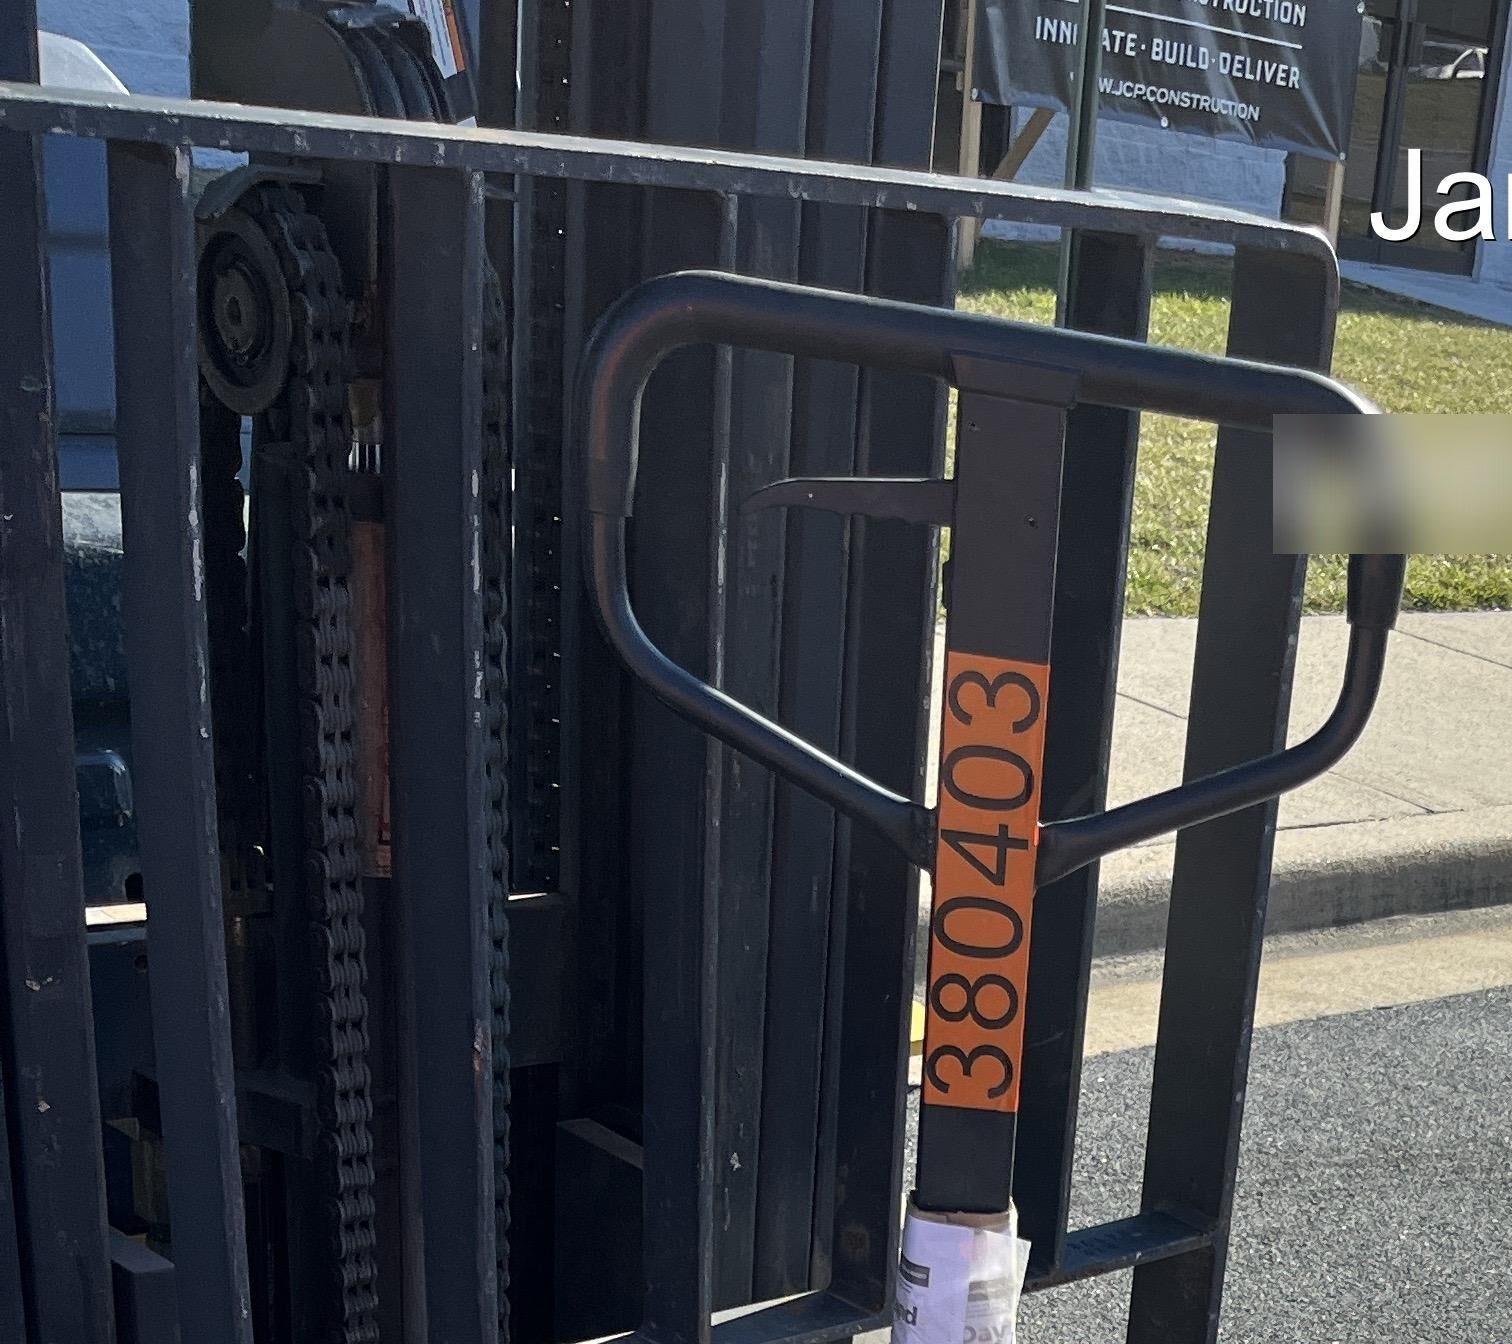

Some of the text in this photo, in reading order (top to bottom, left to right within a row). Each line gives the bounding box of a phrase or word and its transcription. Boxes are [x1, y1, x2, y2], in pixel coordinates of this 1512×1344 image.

[1151, 38, 1210, 71] BUILD
[1219, 52, 1301, 89] DELIVER
[925, 669, 1041, 1100] 380403
